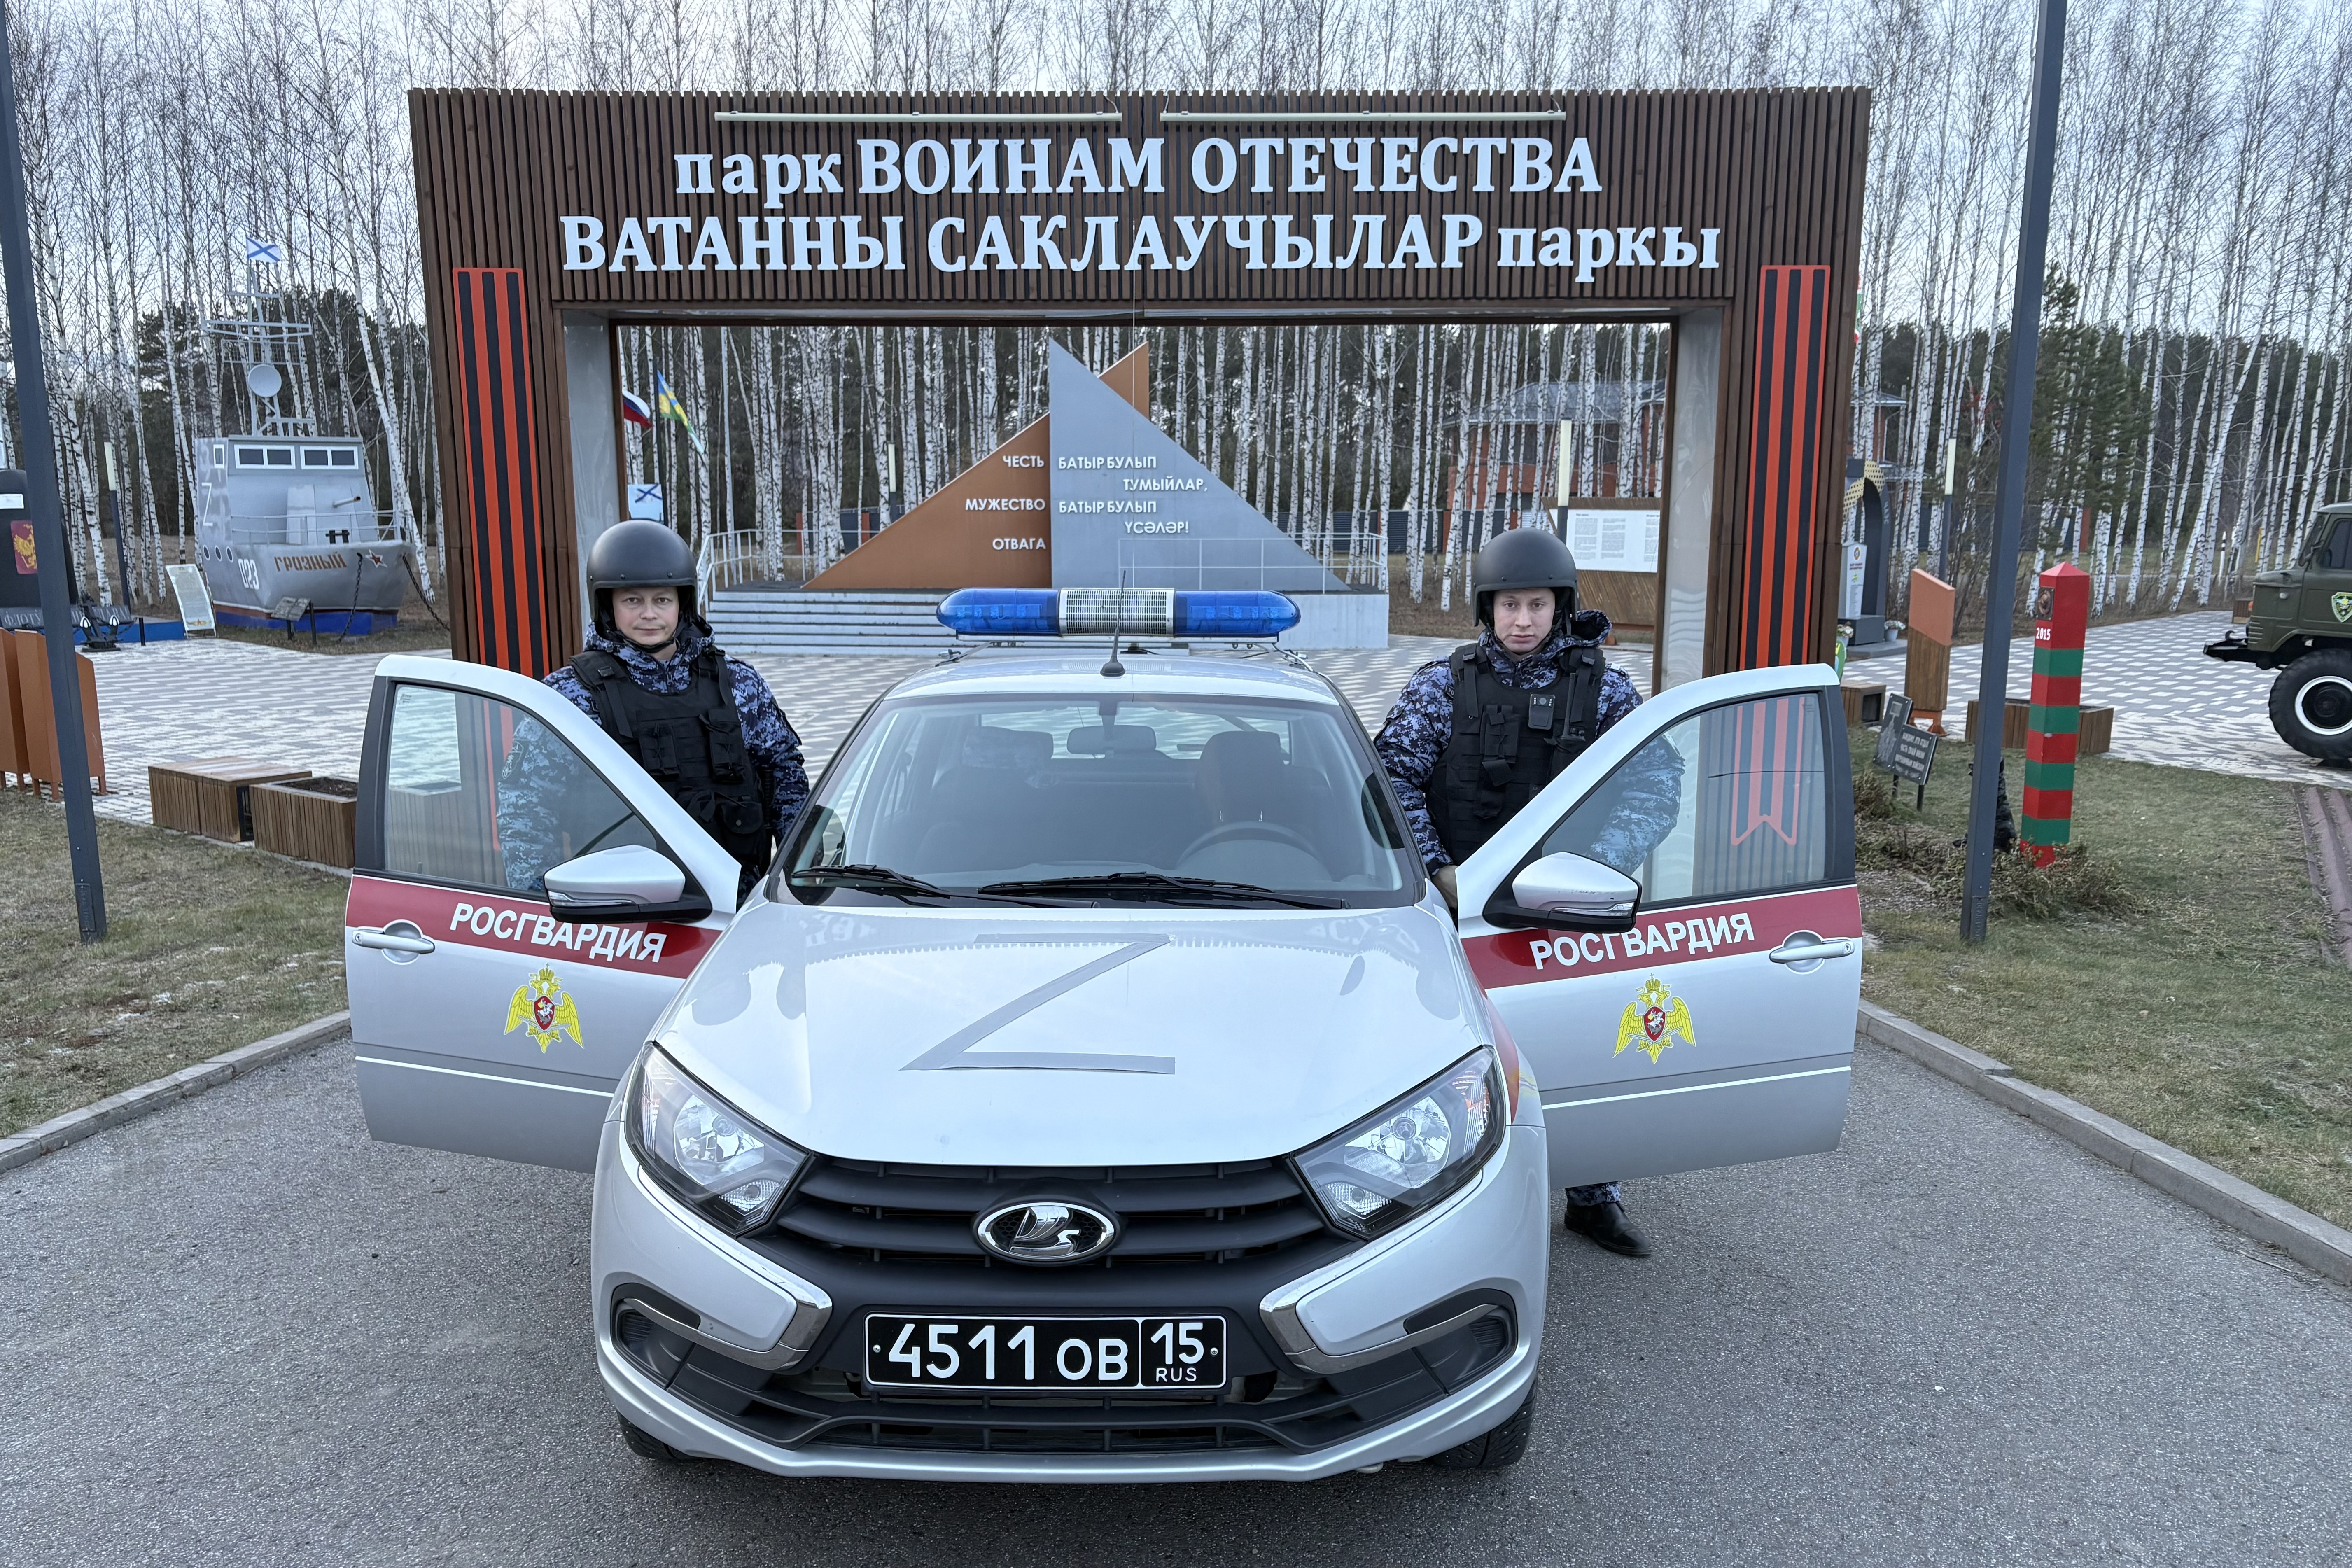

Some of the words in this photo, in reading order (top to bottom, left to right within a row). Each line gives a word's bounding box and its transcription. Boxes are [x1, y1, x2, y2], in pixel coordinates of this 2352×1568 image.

[674, 153, 844, 209] парк
[857, 138, 1165, 194] ВОИНАМ
[1191, 137, 1602, 193] ОТЕЧЕСТВА
[560, 215, 905, 272] ВАТАННЫ
[928, 214, 1483, 273] САКЛАУЧЫЛАР
[1497, 227, 1720, 282] паркы
[1002, 455, 1044, 468] ЧЕСТЬ
[1059, 456, 1104, 469] БАТЫР
[1107, 456, 1157, 469] БУЛЫП
[1123, 475, 1208, 492] ТУМЫЙЛАР,
[965, 498, 1045, 511] МУЖЕСТВО
[1059, 501, 1104, 513] БАТЫР
[1107, 500, 1157, 513] БУЛЫП
[992, 538, 1046, 551] ОТВАГА
[274, 551, 347, 572] ГРОЗНЫЙ
[238, 558, 259, 590] 023
[2036, 627, 2051, 641] 2015
[450, 903, 667, 963] РОСГВАРДИЯ
[1529, 912, 1755, 970] РОСГВАРДИЯ
[898, 933, 1176, 1075] Z
[888, 1323, 1034, 1380] 4511
[1150, 1322, 1204, 1365] 15
[1156, 1367, 1197, 1382] RUS
